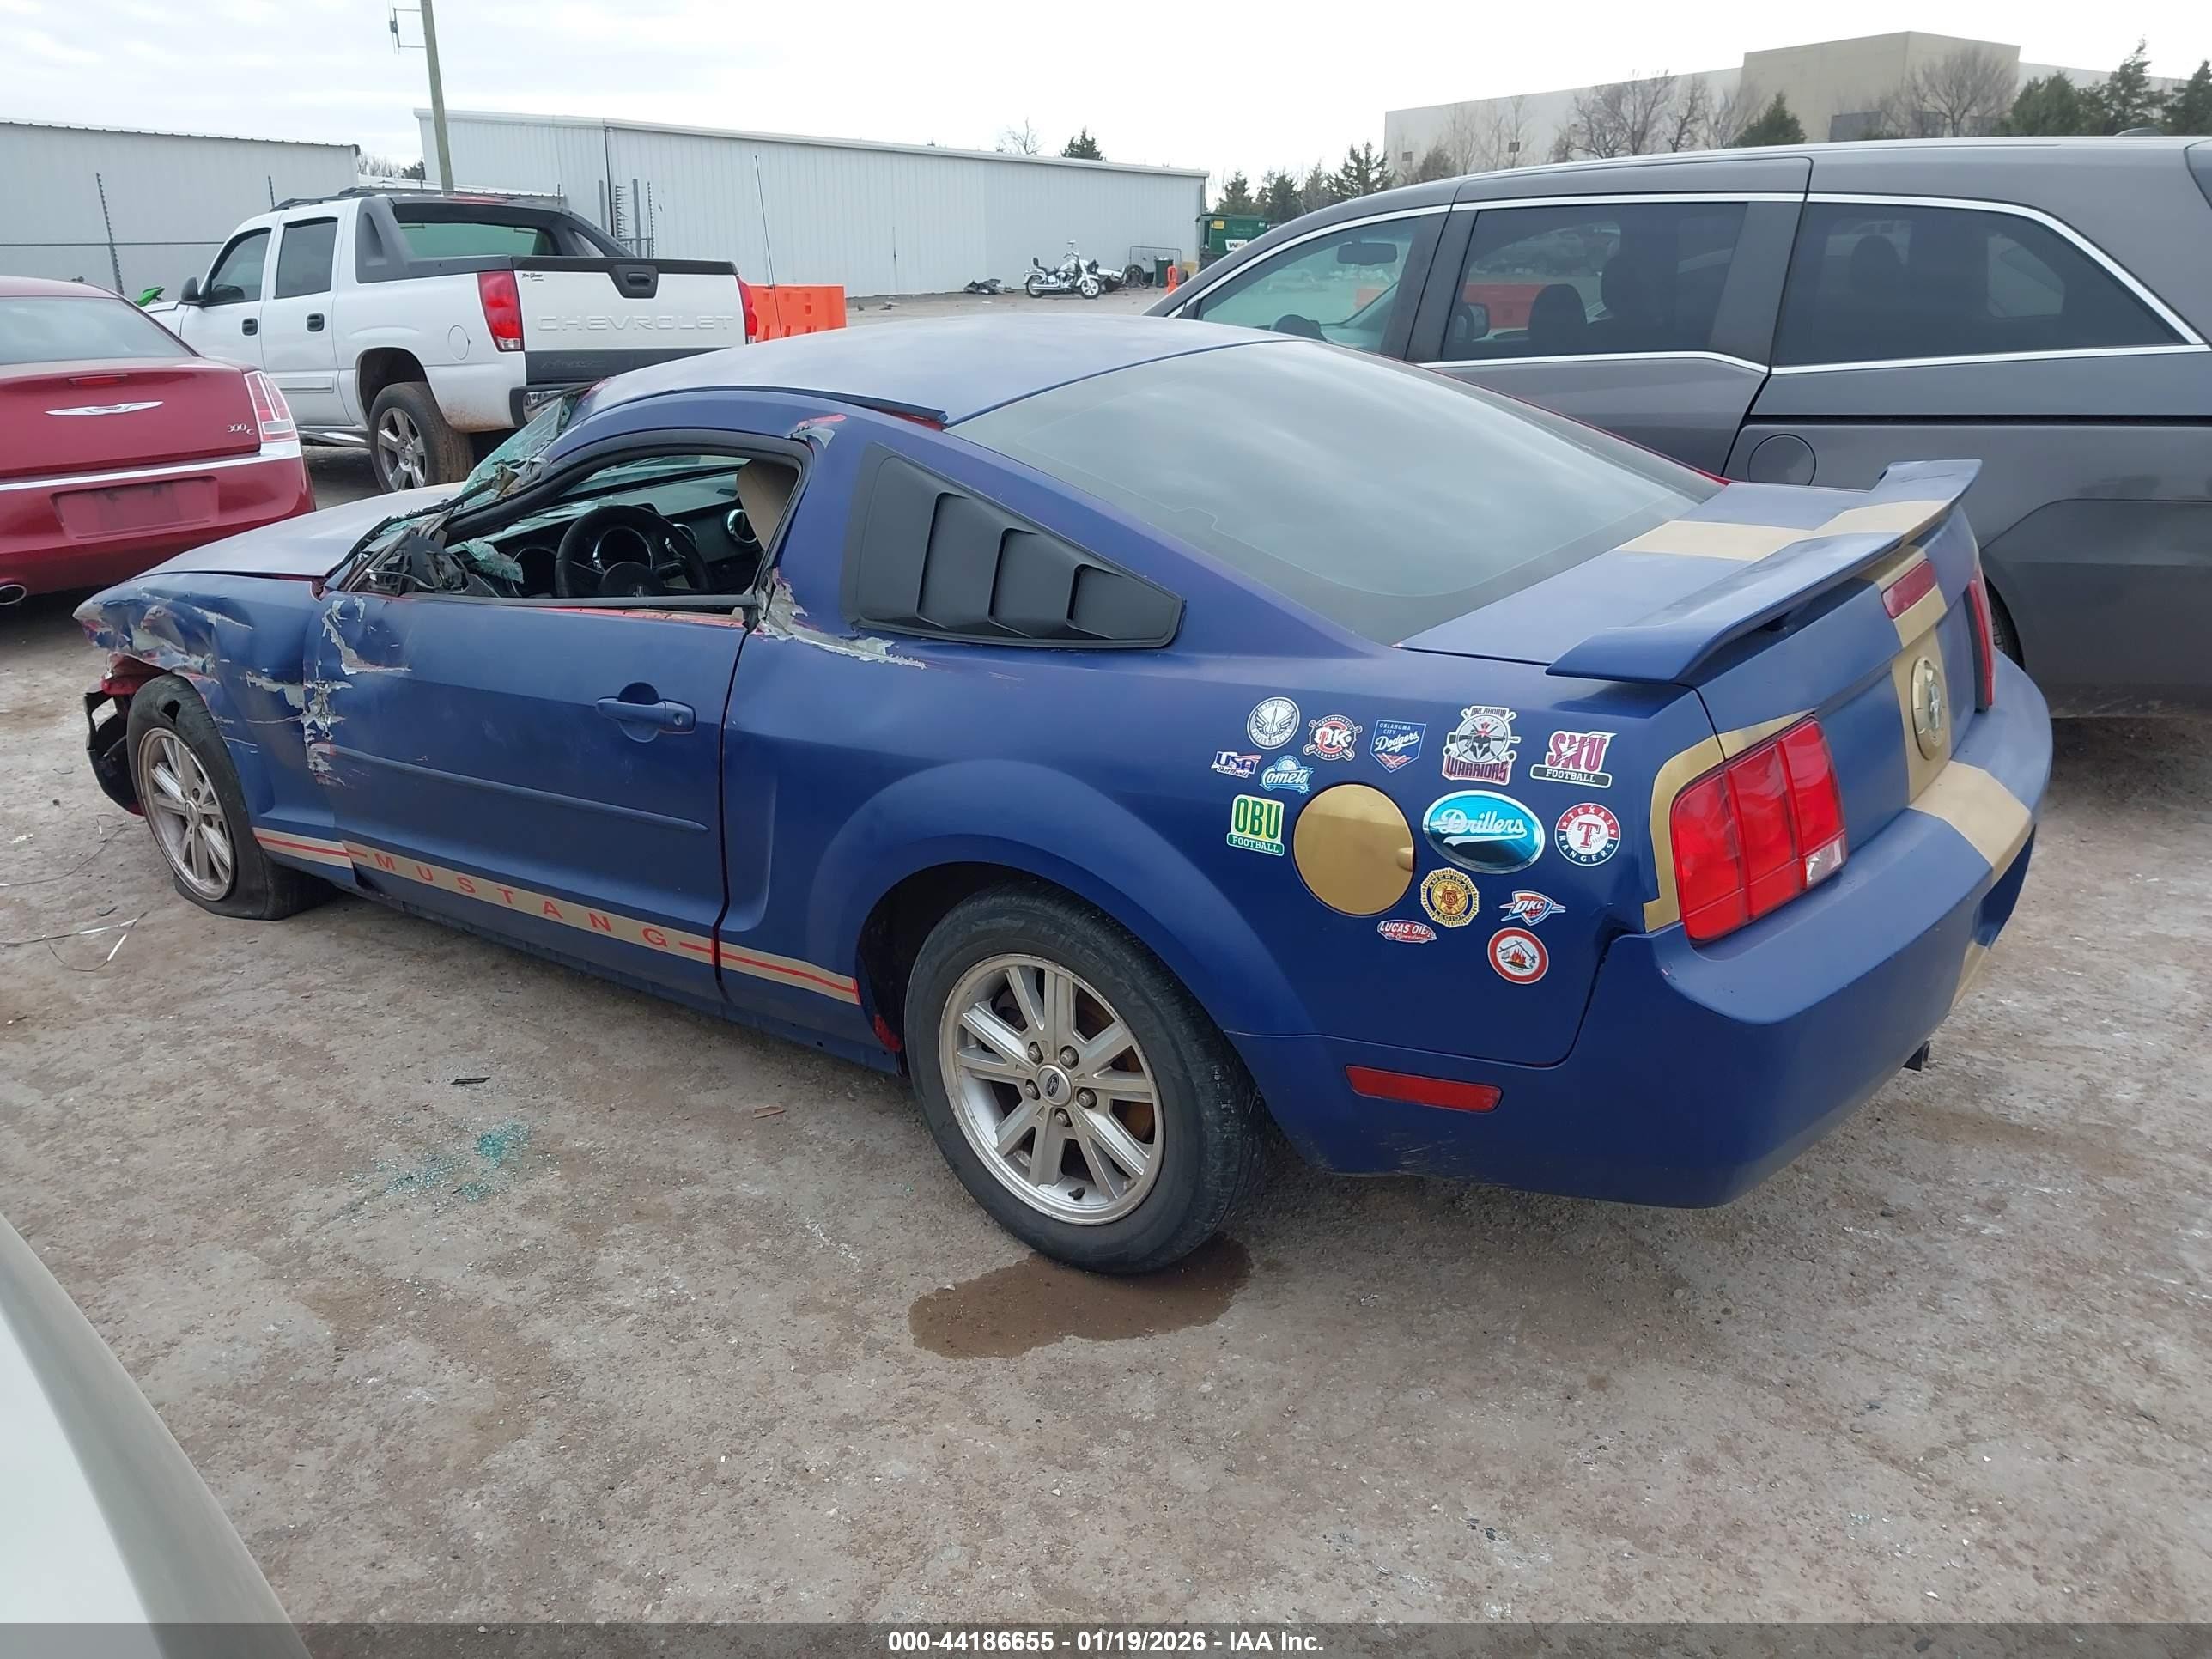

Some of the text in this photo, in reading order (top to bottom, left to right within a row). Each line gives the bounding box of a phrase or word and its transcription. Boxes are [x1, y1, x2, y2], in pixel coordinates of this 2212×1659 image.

[538, 315, 734, 331] CHEVROLET
[1374, 731, 1420, 753] Dodgers
[1547, 733, 1607, 772] SNU
[1216, 752, 1256, 773] USA
[1445, 755, 1509, 781] WARRIORS
[1261, 767, 1309, 789] Comets
[1546, 769, 1595, 782] FOOTBALL
[1234, 798, 1281, 839] OBU
[1439, 808, 1526, 834] Drillers
[1568, 805, 1613, 825] TEXAS
[1232, 836, 1279, 854] FOOTBALL
[1577, 821, 1601, 848] T
[1559, 835, 1614, 862] RANGERS
[1429, 876, 1472, 895] AMERICAN
[374, 853, 668, 948] MUSTANG
[1444, 895, 1455, 905] US
[1511, 900, 1544, 914] OKC
[1379, 922, 1410, 933] LUCAS
